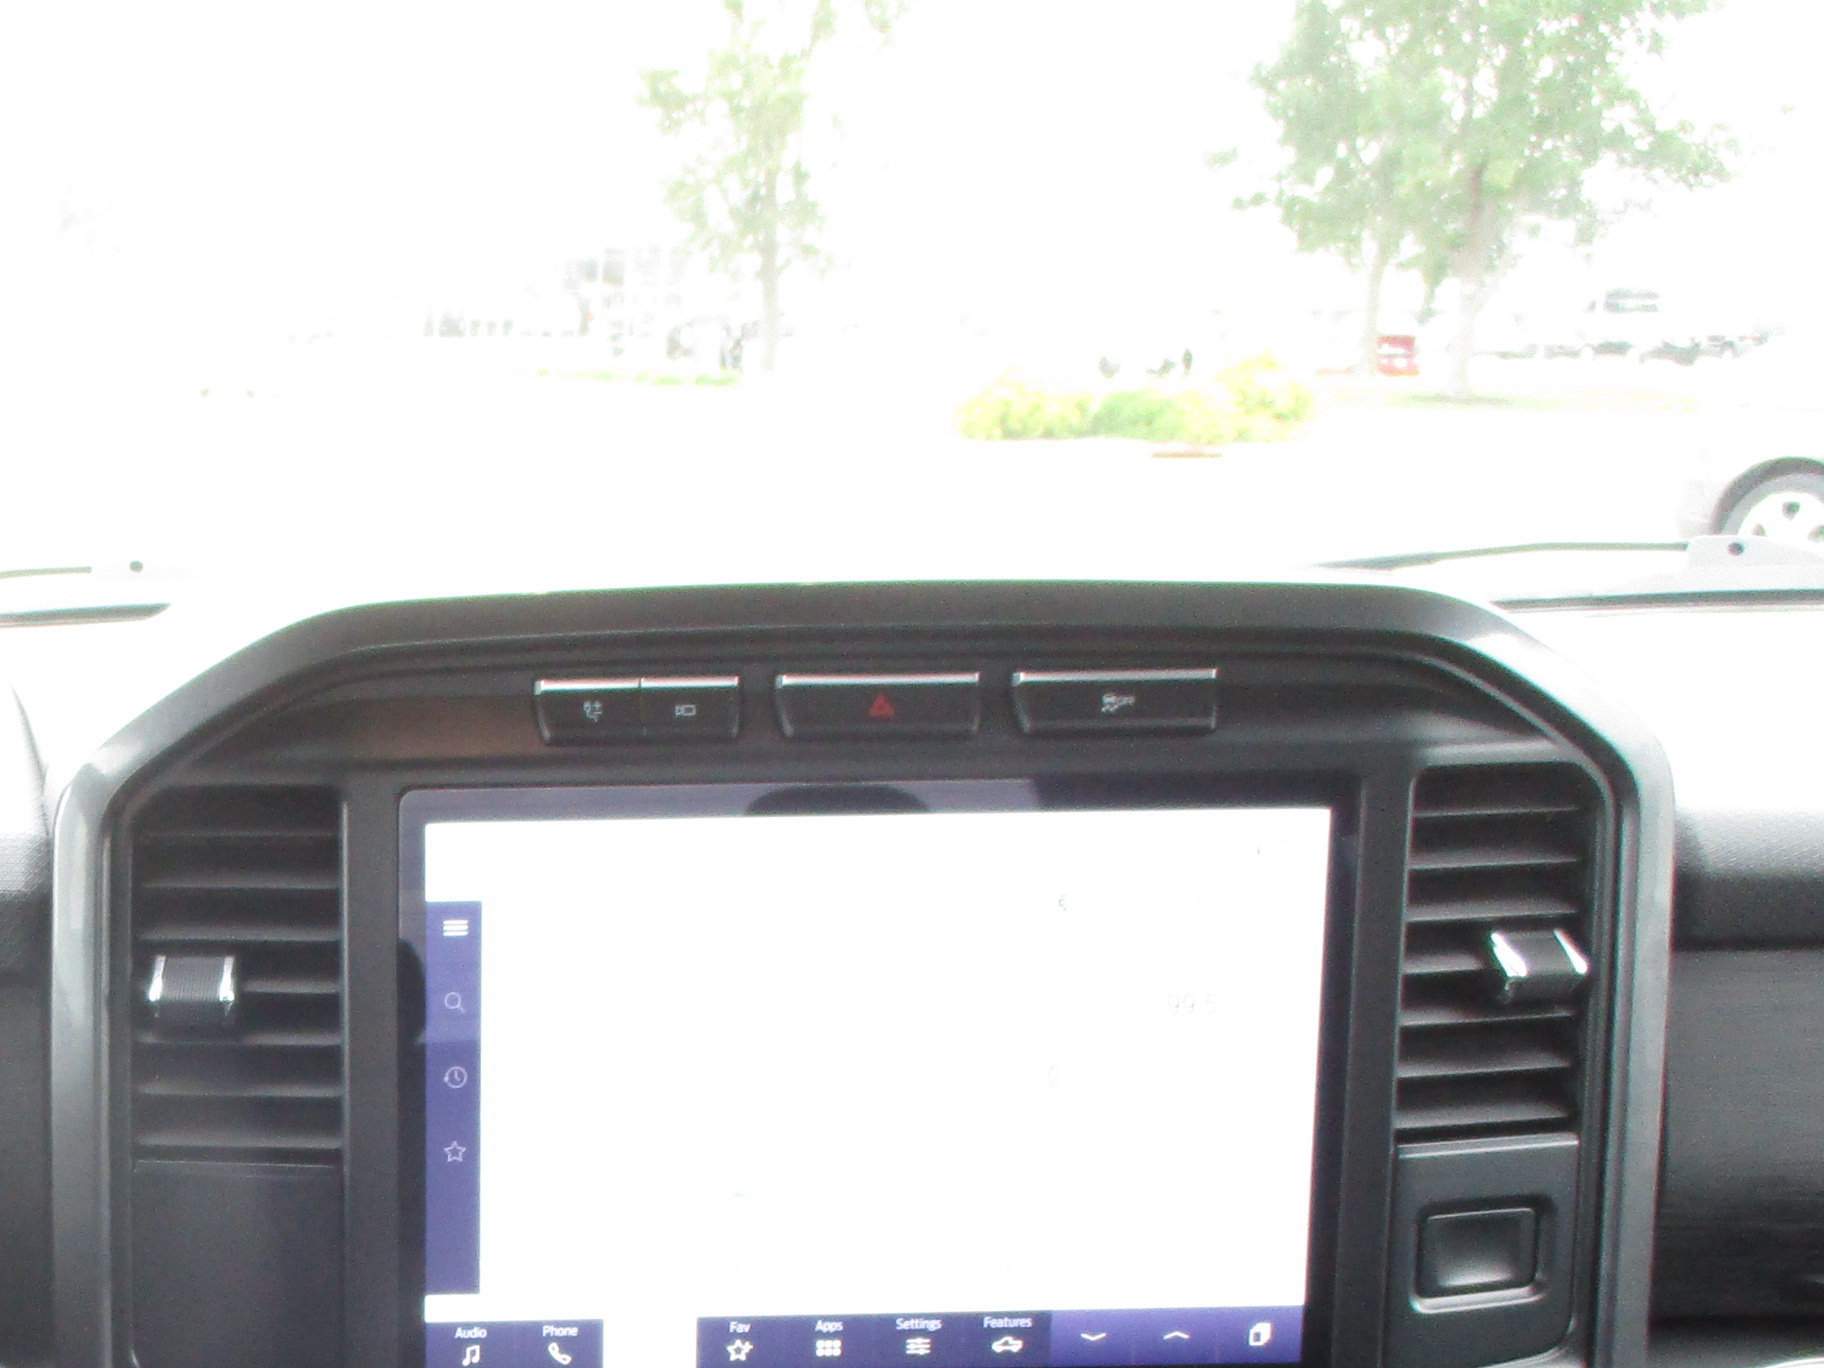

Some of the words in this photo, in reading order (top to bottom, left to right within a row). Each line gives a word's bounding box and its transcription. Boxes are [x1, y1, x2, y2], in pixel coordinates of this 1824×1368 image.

[454, 1326, 488, 1340] Audio
[542, 1324, 579, 1338] Phone
[729, 1320, 752, 1335] Fav
[814, 1319, 844, 1335] Apps
[895, 1317, 943, 1332] Settings
[982, 1315, 1033, 1329] Features
